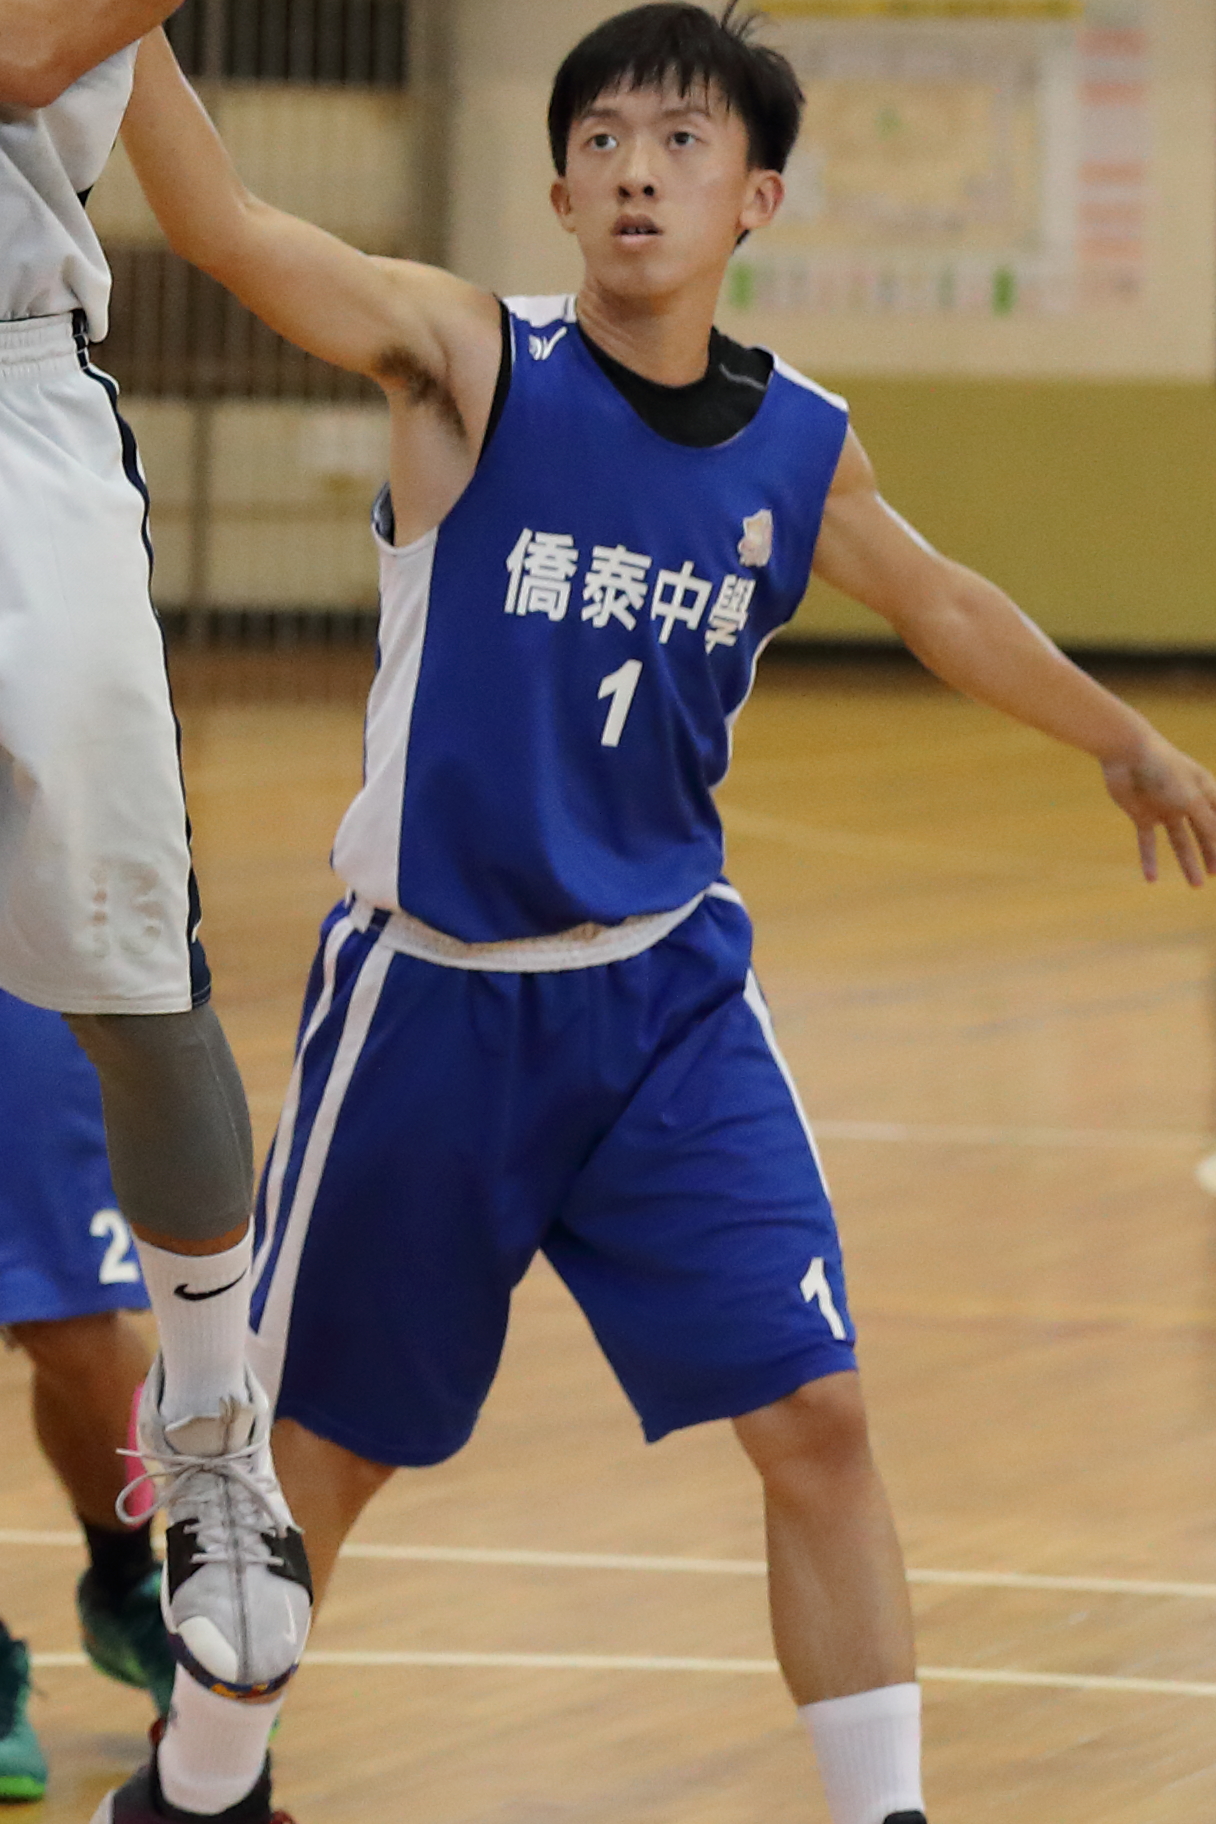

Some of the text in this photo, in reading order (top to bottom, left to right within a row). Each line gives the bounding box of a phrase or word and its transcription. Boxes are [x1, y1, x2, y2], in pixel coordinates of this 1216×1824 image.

[503, 527, 757, 654] 僑泰中學
[597, 658, 644, 748] 1
[799, 1256, 847, 1341] 1
